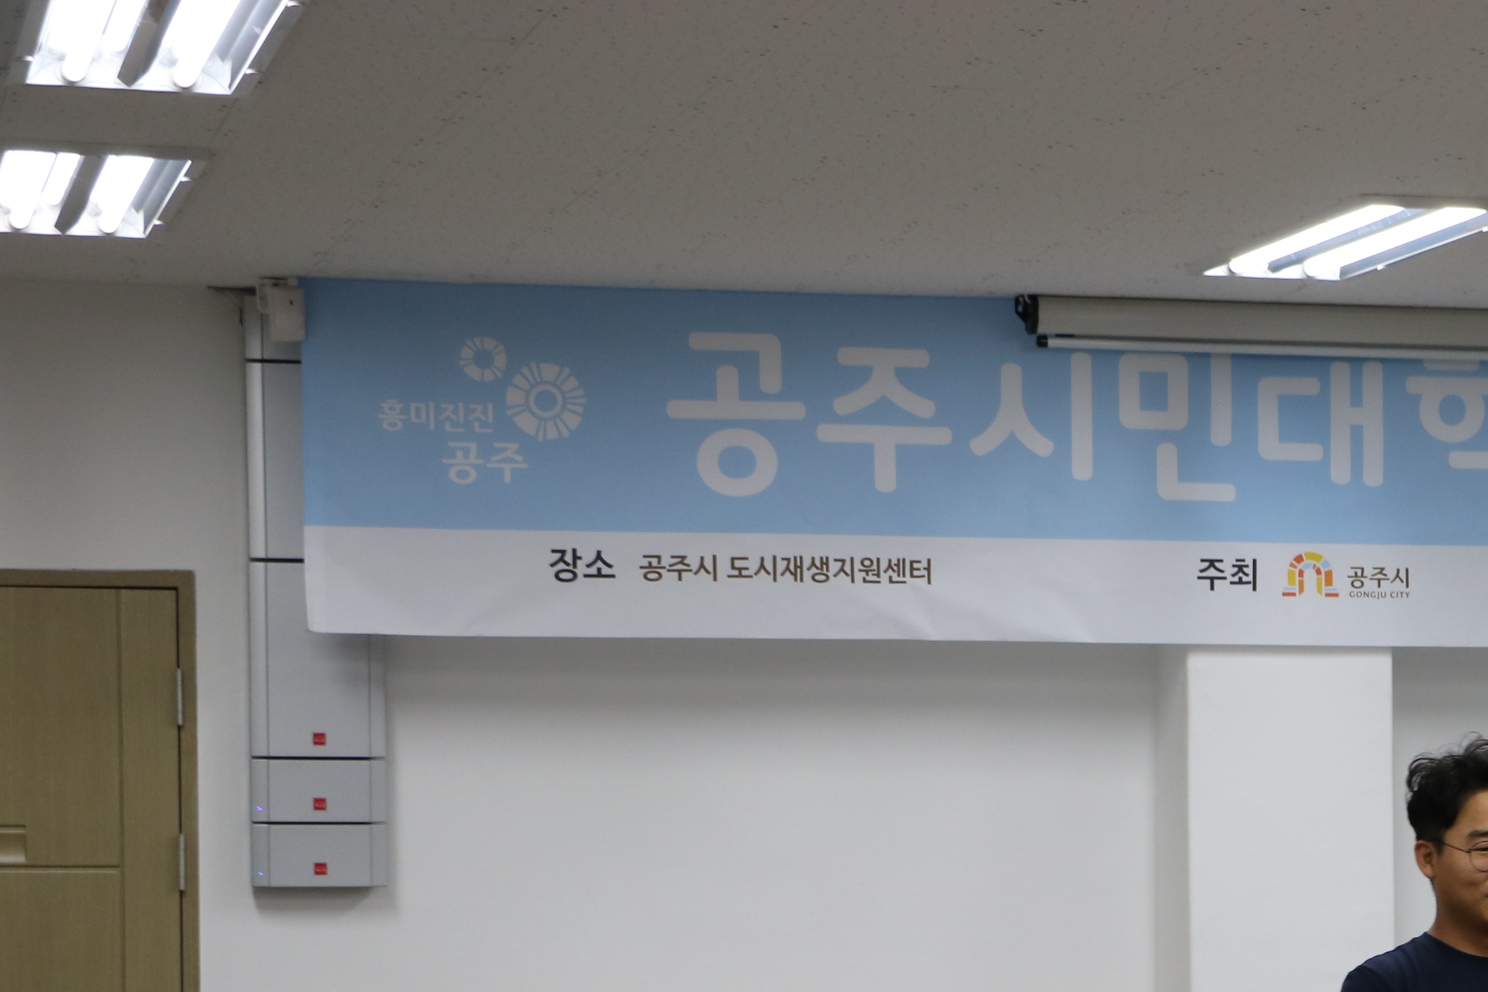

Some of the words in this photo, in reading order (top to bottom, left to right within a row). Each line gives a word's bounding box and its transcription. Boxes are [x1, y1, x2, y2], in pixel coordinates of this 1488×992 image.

[378, 399, 495, 433] 흥미진진
[442, 441, 529, 485] 공주
[548, 547, 617, 584] 장소
[638, 554, 718, 583] 공주시
[726, 554, 932, 585] 도시재생지원센터
[1196, 558, 1258, 592] 주최
[1347, 566, 1410, 589] 공주시
[1349, 591, 1387, 600] GONGJU
[1389, 591, 1411, 599] CITY
